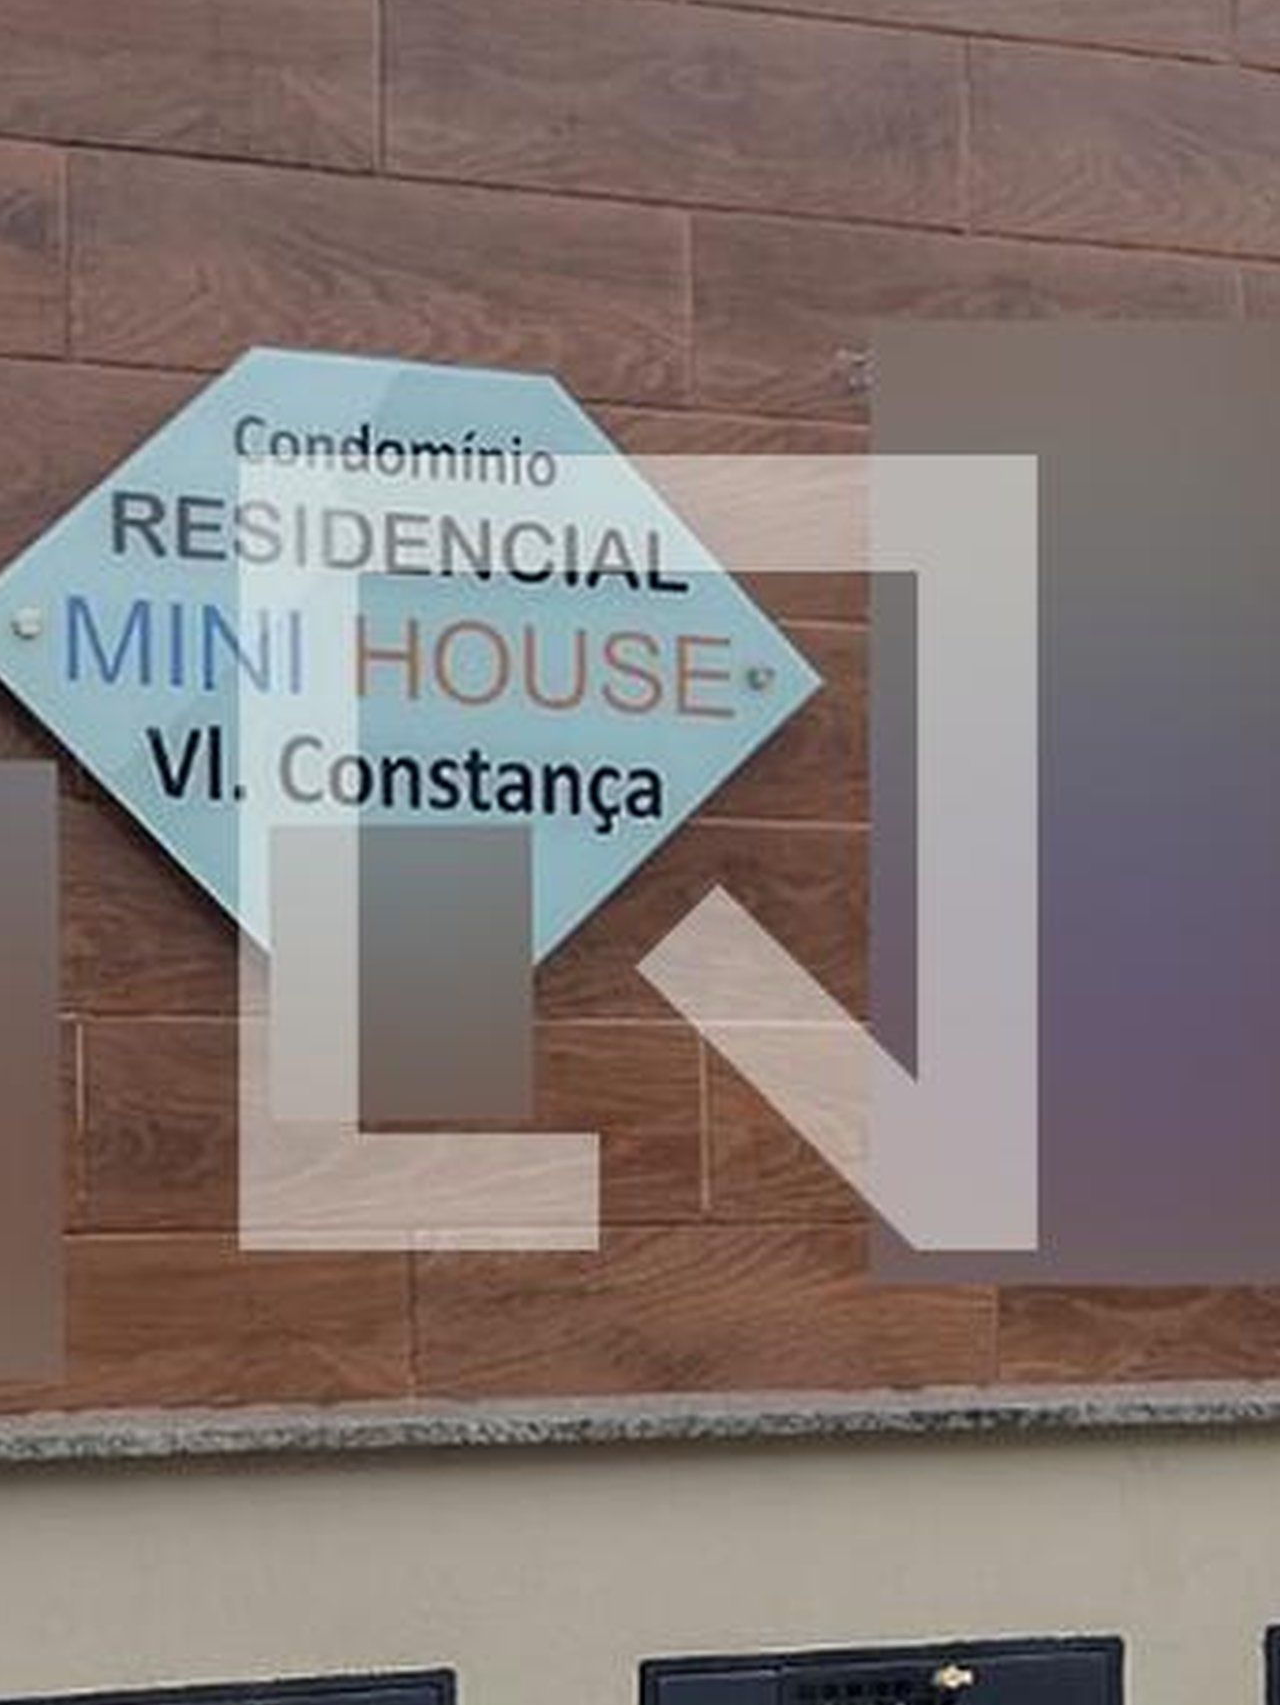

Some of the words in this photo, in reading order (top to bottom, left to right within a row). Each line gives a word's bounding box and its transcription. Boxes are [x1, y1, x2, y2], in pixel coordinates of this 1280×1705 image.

[233, 414, 558, 487] Condomínio
[109, 490, 690, 594] RESIDENCIAL
[64, 594, 304, 694] MINI
[354, 614, 737, 719] HOUSE
[277, 734, 664, 835] Constança
